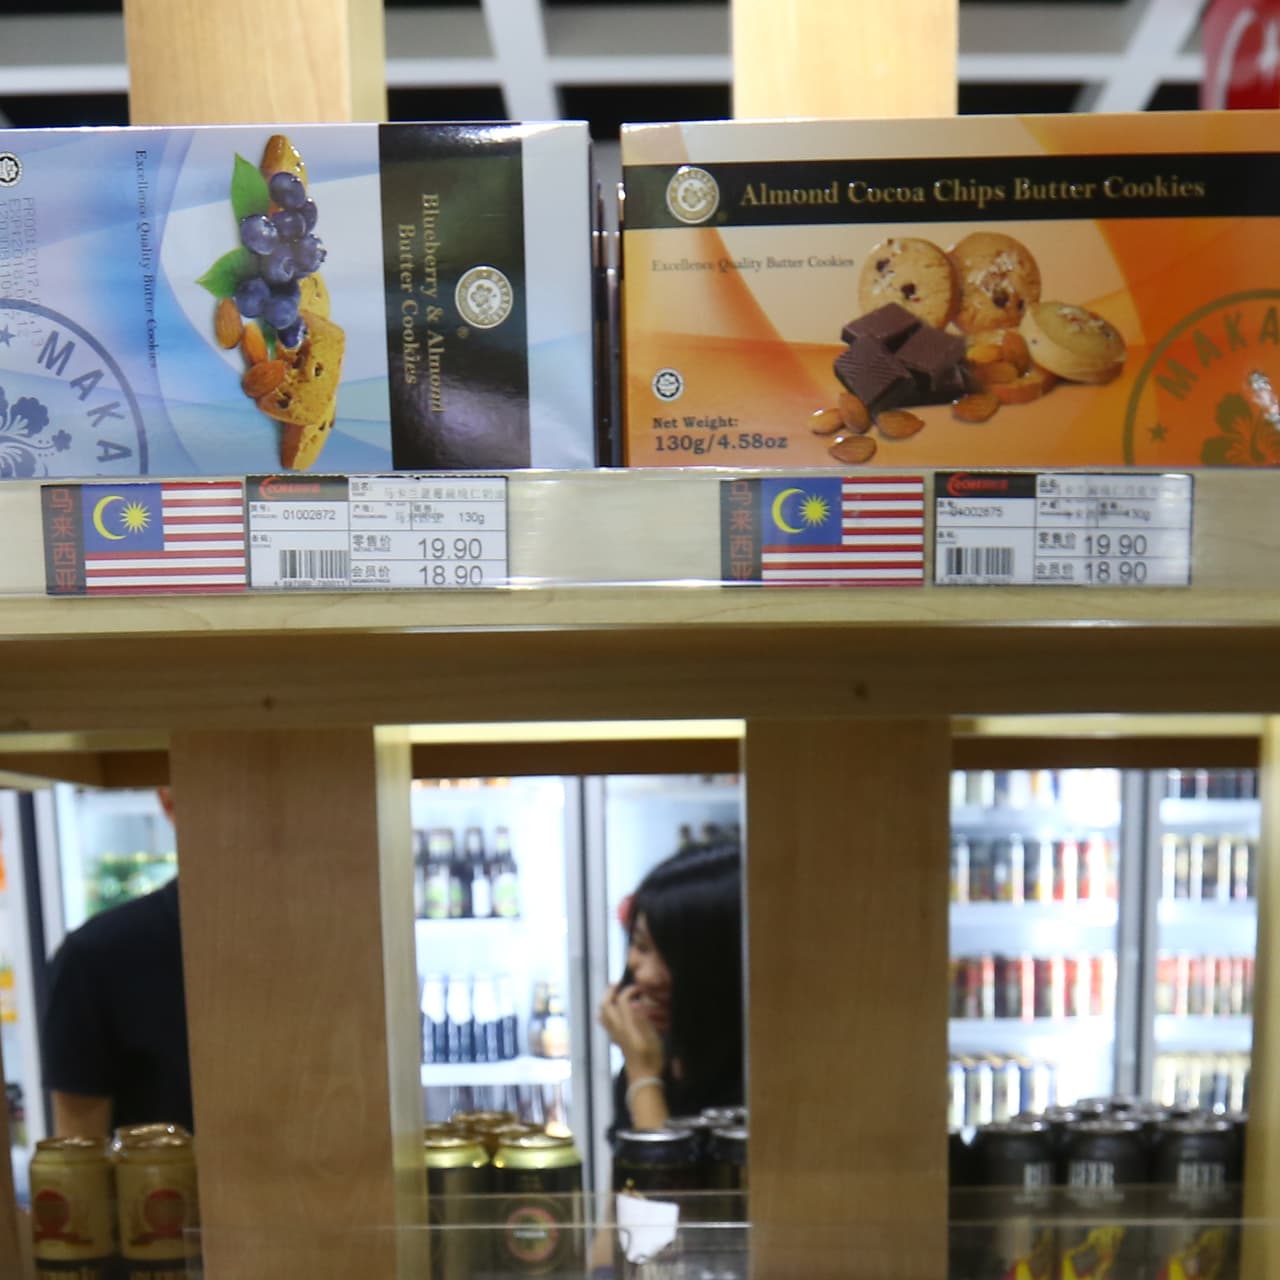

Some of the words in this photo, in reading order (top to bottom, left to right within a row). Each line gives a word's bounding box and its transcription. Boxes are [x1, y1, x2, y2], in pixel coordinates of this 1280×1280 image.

[740, 181, 839, 207] Almond
[848, 180, 926, 205] Cocoa
[933, 178, 1007, 208] Chips
[1013, 177, 1097, 202] Butter
[1103, 175, 1205, 200] Cookies
[421, 194, 441, 298] Blueberry
[398, 224, 417, 292] Butter
[401, 300, 420, 385] Cookies
[427, 330, 447, 413] Almond
[652, 416, 682, 430] Net
[686, 416, 738, 432] Weight:
[654, 432, 788, 454] 130g/4.58oz
[458, 511, 485, 525] 130g
[50, 488, 77, 591] 马来西亚
[417, 537, 483, 559] 19.90
[1084, 534, 1147, 555] 19.90
[418, 565, 484, 586] 18.90
[1085, 561, 1147, 582] 18.90
